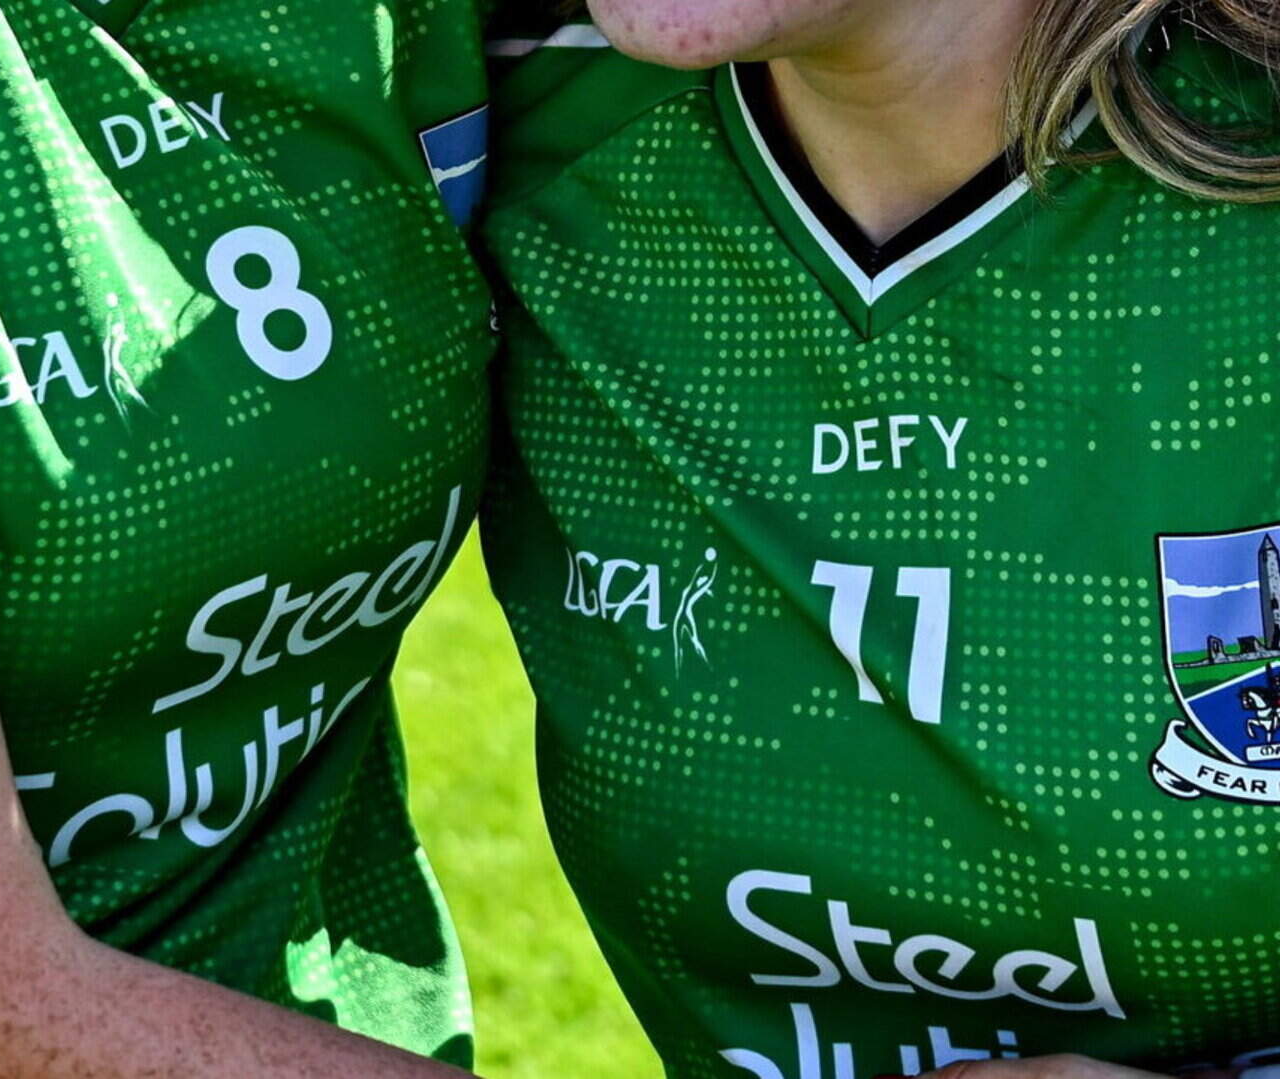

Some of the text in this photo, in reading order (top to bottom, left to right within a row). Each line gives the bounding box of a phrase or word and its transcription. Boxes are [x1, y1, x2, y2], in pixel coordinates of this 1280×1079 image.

[99, 91, 231, 170] DEY
[206, 225, 333, 382] 8
[812, 414, 968, 475] DEFY
[151, 484, 462, 714] Steel
[564, 546, 669, 631] LGFA
[810, 559, 951, 725] 11
[1197, 765, 1268, 794] FEAR
[725, 869, 1127, 1020] Steel
